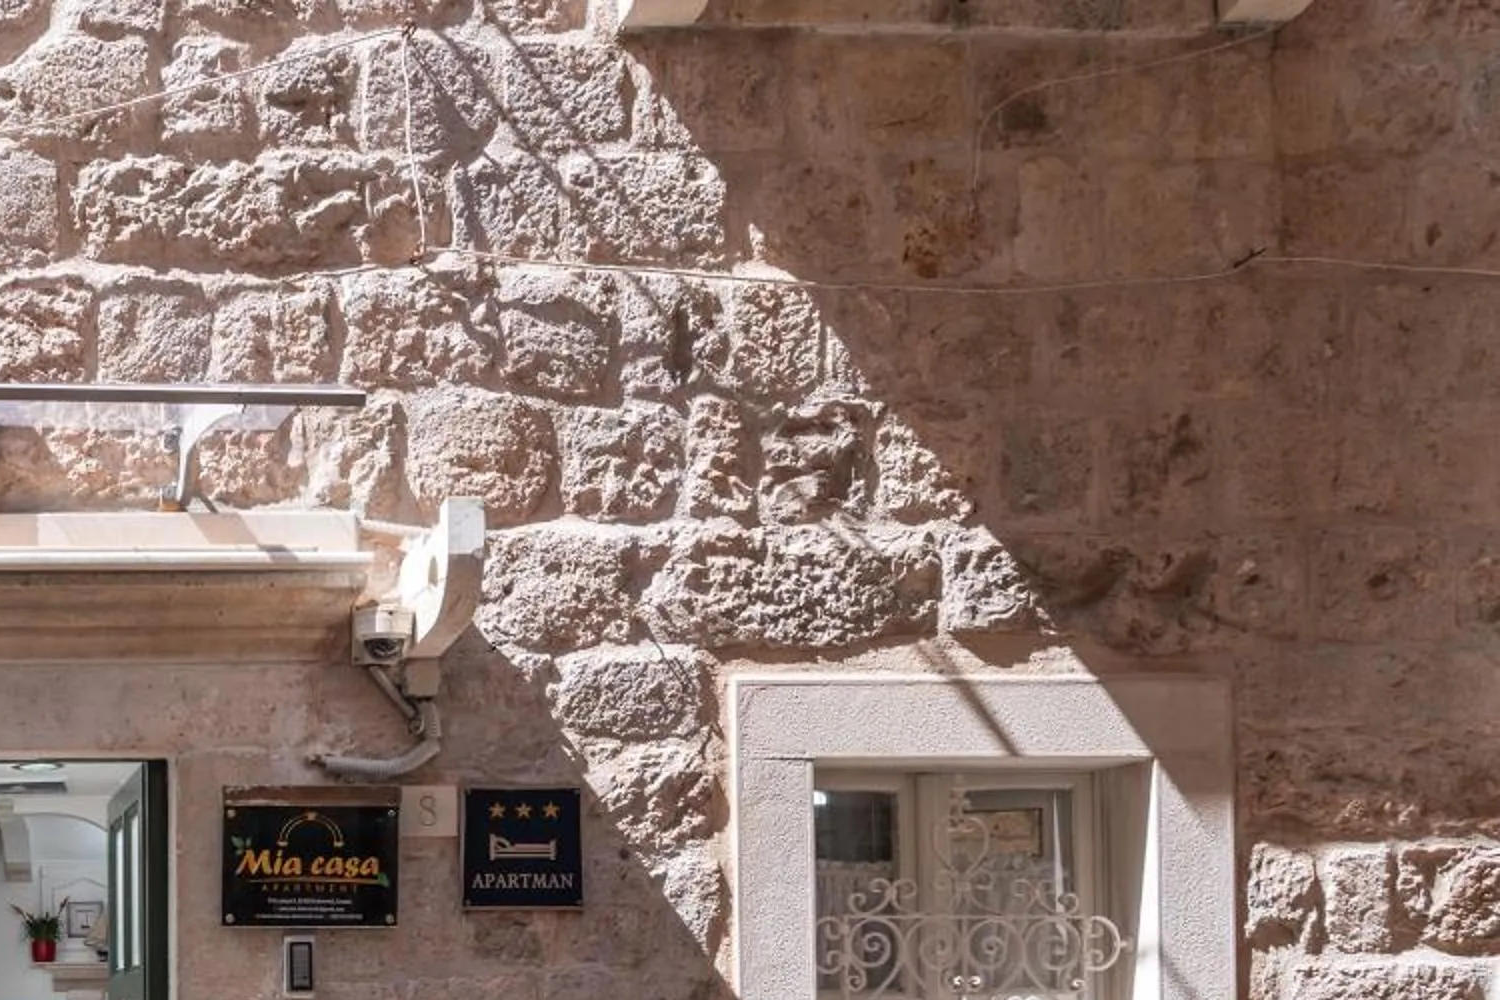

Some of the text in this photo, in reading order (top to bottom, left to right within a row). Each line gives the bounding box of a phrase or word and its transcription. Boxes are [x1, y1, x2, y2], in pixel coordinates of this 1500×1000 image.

[235, 848, 380, 878] Mia casa
[472, 872, 574, 890] APARTMAN
